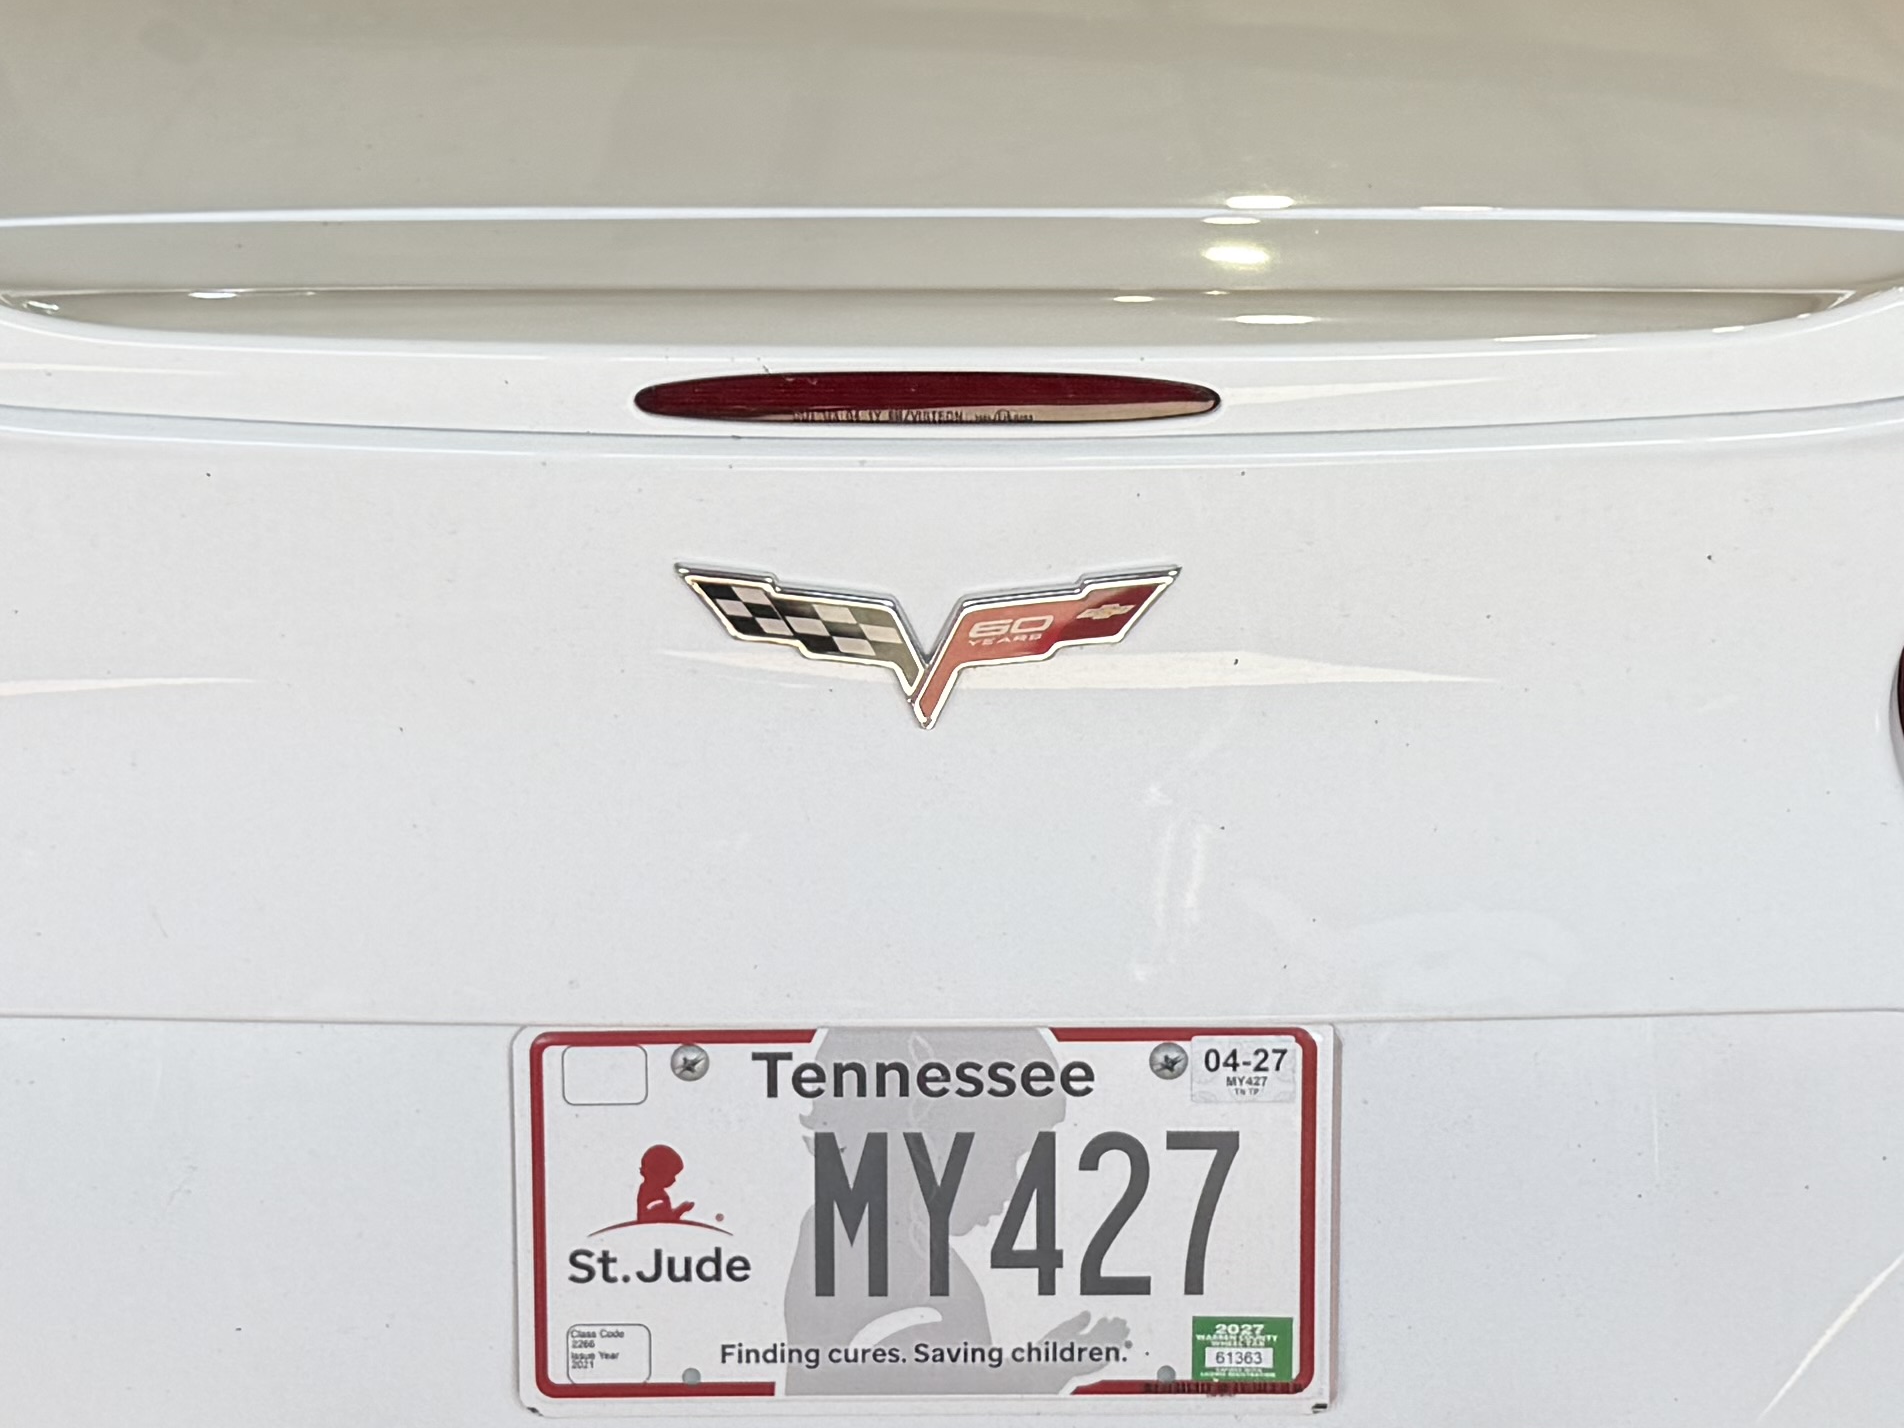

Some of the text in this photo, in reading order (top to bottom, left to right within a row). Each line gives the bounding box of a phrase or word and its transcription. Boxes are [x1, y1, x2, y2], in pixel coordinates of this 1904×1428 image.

[968, 614, 1054, 638] 60
[1204, 1047, 1288, 1072] 04-27
[751, 1051, 1095, 1098] Tennessee
[1226, 1075, 1268, 1087] MY427
[814, 1130, 1240, 1298] MY427
[599, 1329, 625, 1339] Code
[1215, 1323, 1264, 1334] 2027
[720, 1341, 1128, 1369] Finding cures. Saving children.
[1215, 1351, 1263, 1364] 61363
